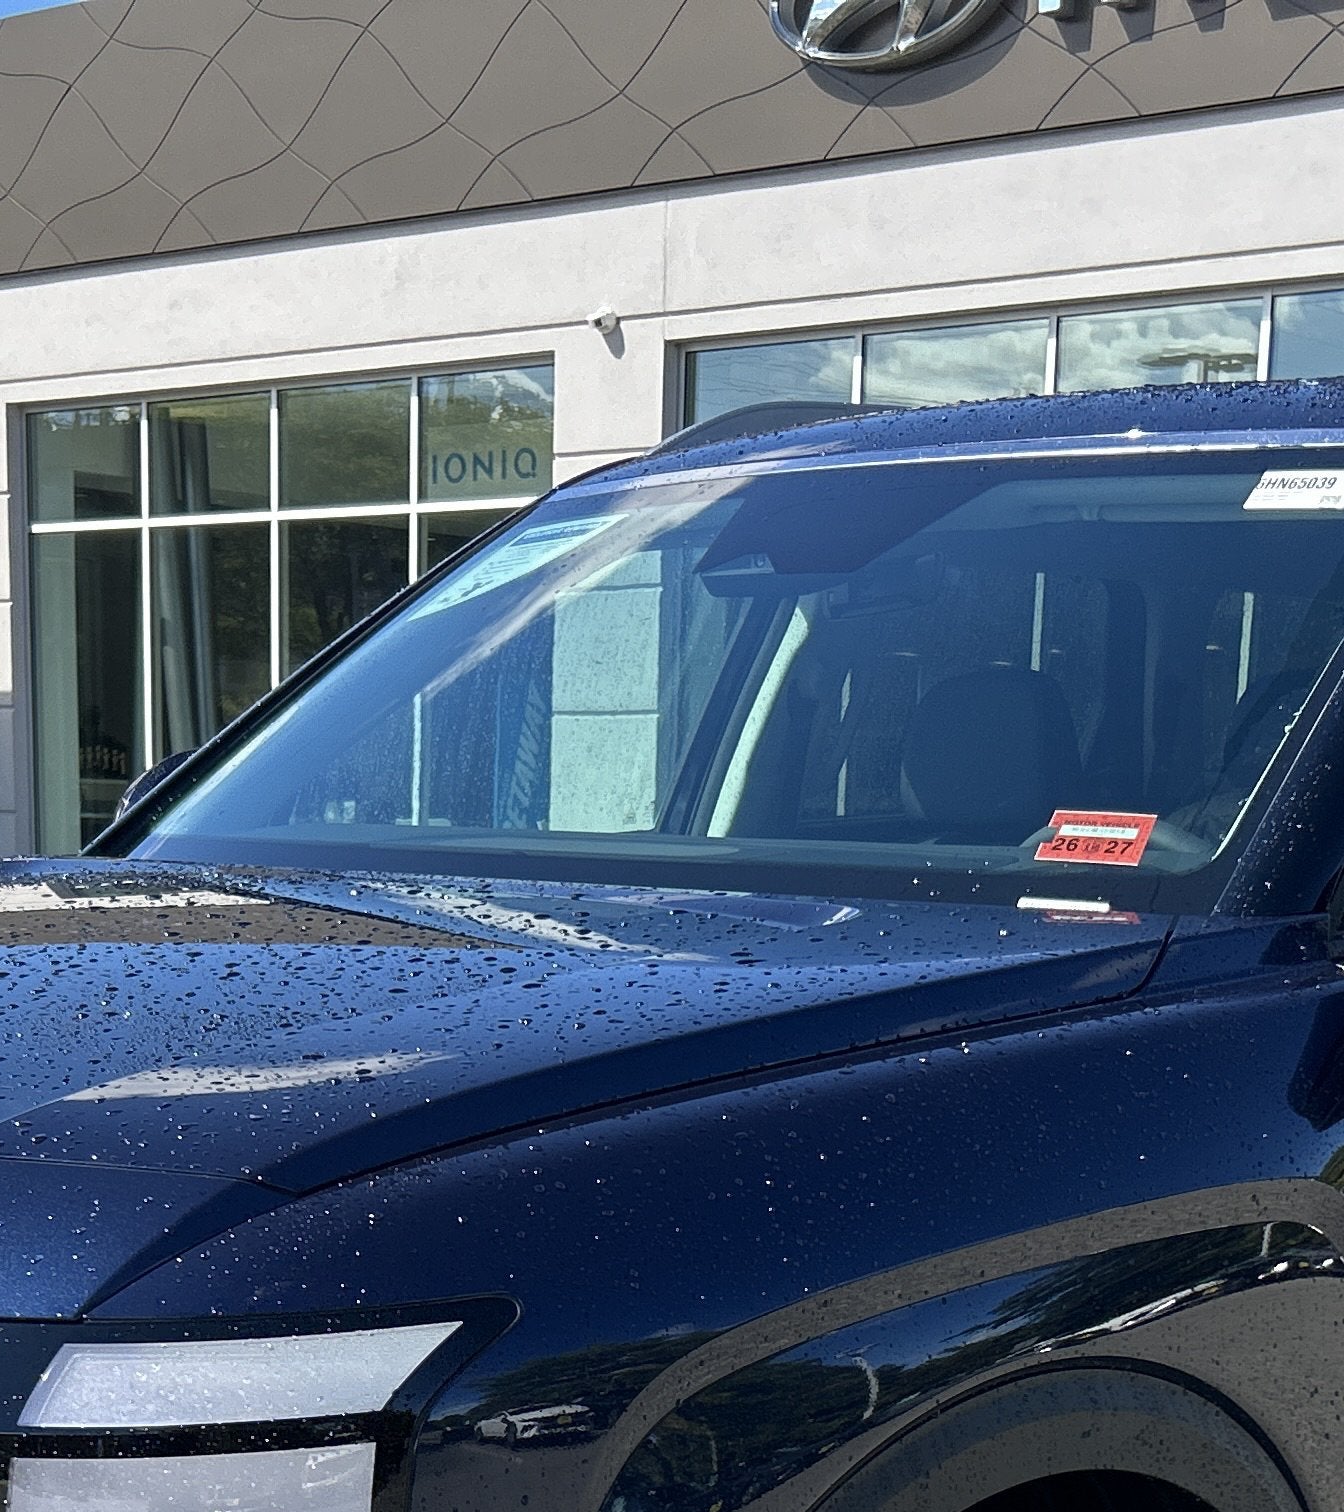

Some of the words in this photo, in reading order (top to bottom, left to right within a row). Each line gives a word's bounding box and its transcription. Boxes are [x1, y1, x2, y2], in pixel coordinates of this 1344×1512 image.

[431, 447, 537, 484] IONIQ
[1051, 838, 1080, 851] 26
[1103, 840, 1134, 855] 27
